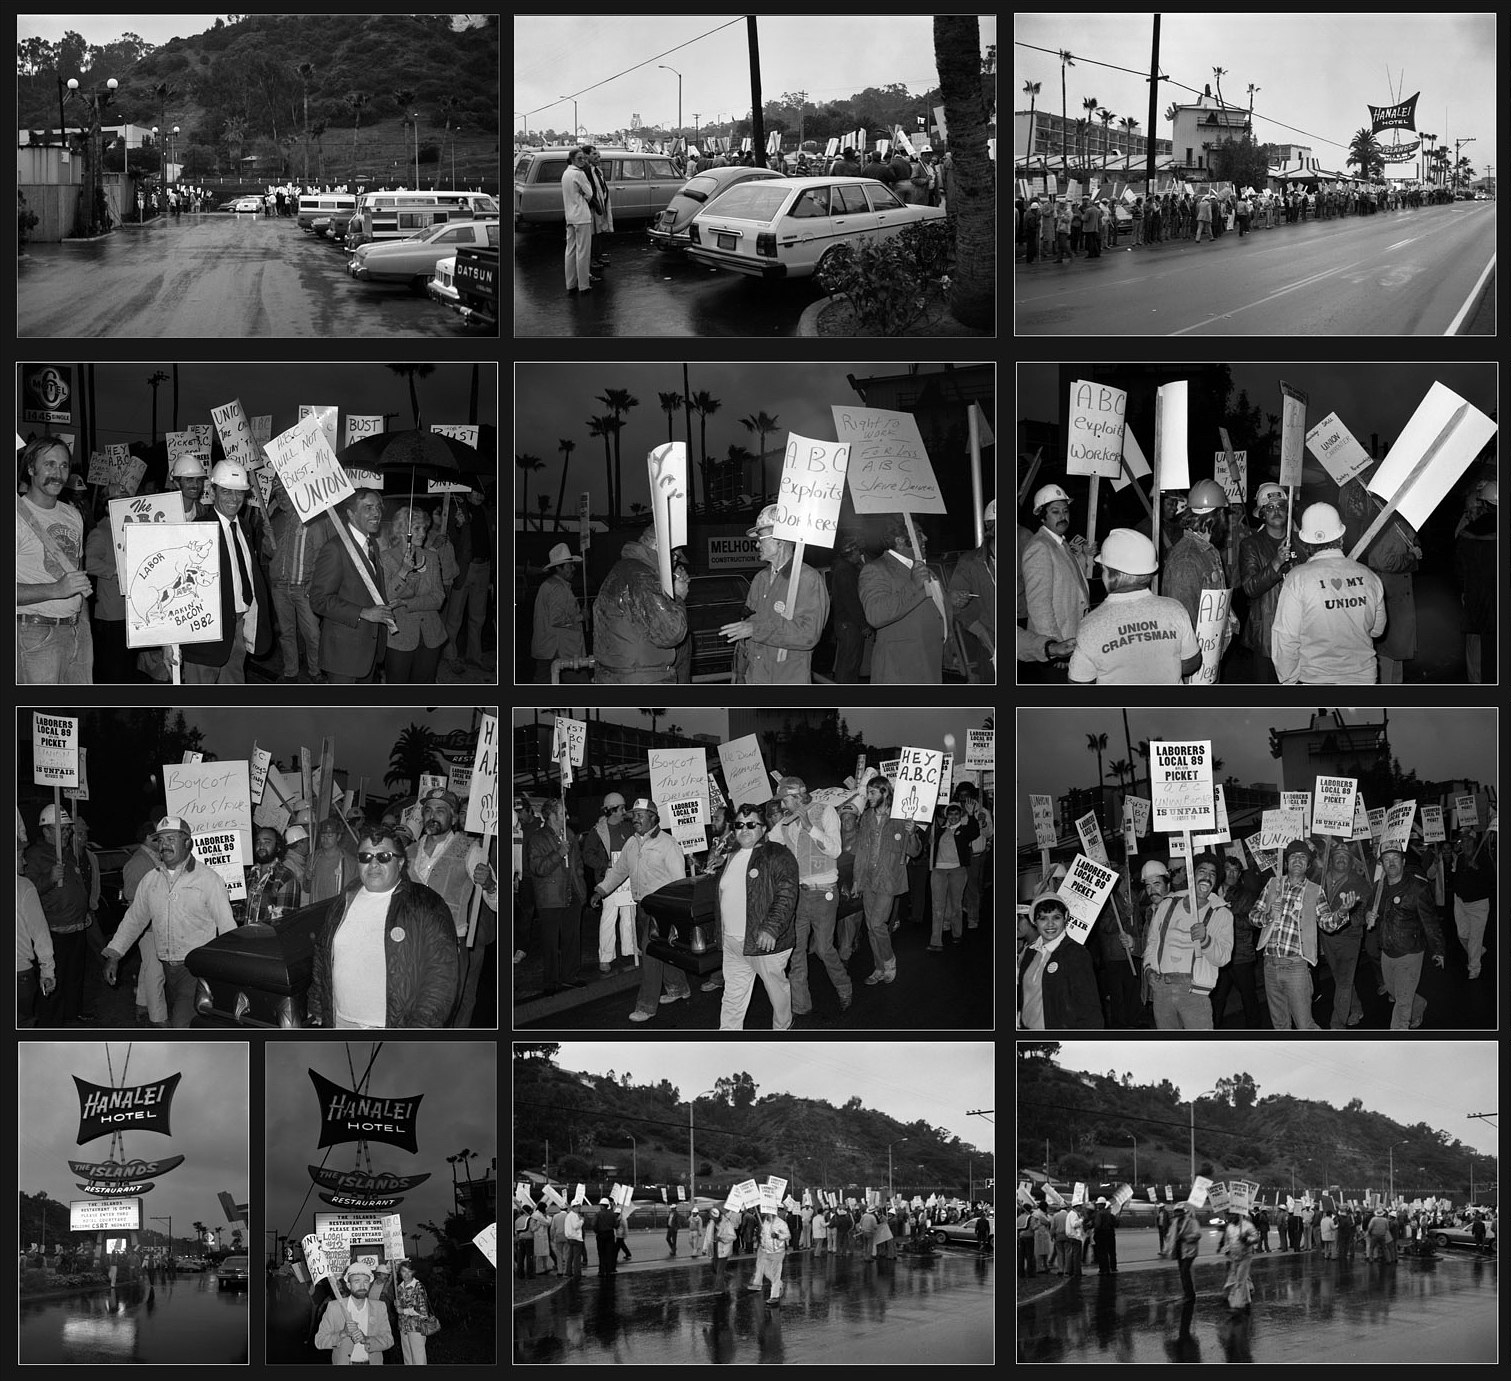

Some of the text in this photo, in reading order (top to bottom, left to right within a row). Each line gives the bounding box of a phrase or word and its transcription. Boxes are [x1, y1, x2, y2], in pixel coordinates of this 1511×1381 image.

[1372, 105, 1412, 122] HANALEI
[457, 264, 493, 283] DATSUN
[350, 419, 379, 432] BUST
[841, 415, 880, 433] Right
[302, 429, 319, 450] NOT
[1321, 432, 1340, 451] UNION
[107, 445, 126, 454] HEY
[295, 471, 347, 513] UNION
[780, 478, 843, 502] exploits
[130, 499, 152, 512] The
[711, 540, 759, 553] MELHOR
[711, 555, 755, 563] CONSTRUCTION
[139, 552, 166, 580] LABOR
[1320, 577, 1364, 589] I MY
[1325, 596, 1366, 609] UNION
[174, 604, 204, 627] BACON
[191, 614, 214, 632] 1982
[1118, 620, 1158, 636] UNION
[1102, 630, 1176, 653] CRAFTSMAN
[36, 716, 73, 729] LABORERS
[38, 725, 71, 736] LOCAL 89
[41, 738, 66, 748] PICKET
[902, 750, 936, 765] HEY
[1156, 746, 1205, 756] LABORERS
[1159, 756, 1203, 766] LOCAL 89
[900, 767, 936, 784] A.B.C.
[1166, 771, 1198, 781] PICKET
[1320, 779, 1352, 788] LABORERS
[671, 801, 698, 811] LABORERS
[1324, 796, 1346, 804] PICKET
[673, 809, 690, 817] LOCAL
[1169, 807, 1210, 815] UNFAIR
[678, 817, 696, 825] PICKET
[195, 834, 235, 847] LABORERS
[198, 843, 234, 854] LOCAL 89
[204, 855, 231, 865] PICKET
[1076, 859, 1112, 882] LABORERS
[1071, 881, 1096, 899] PICKET
[83, 1085, 165, 1119] HANALEI
[328, 1094, 412, 1120] HANALEI
[101, 1111, 156, 1123] HOTEL
[348, 1123, 405, 1133] HOTEL
[89, 1162, 158, 1177] ISLANDS
[339, 1176, 410, 1190] ISLANDS
[332, 1196, 395, 1206] RESTAURANT
